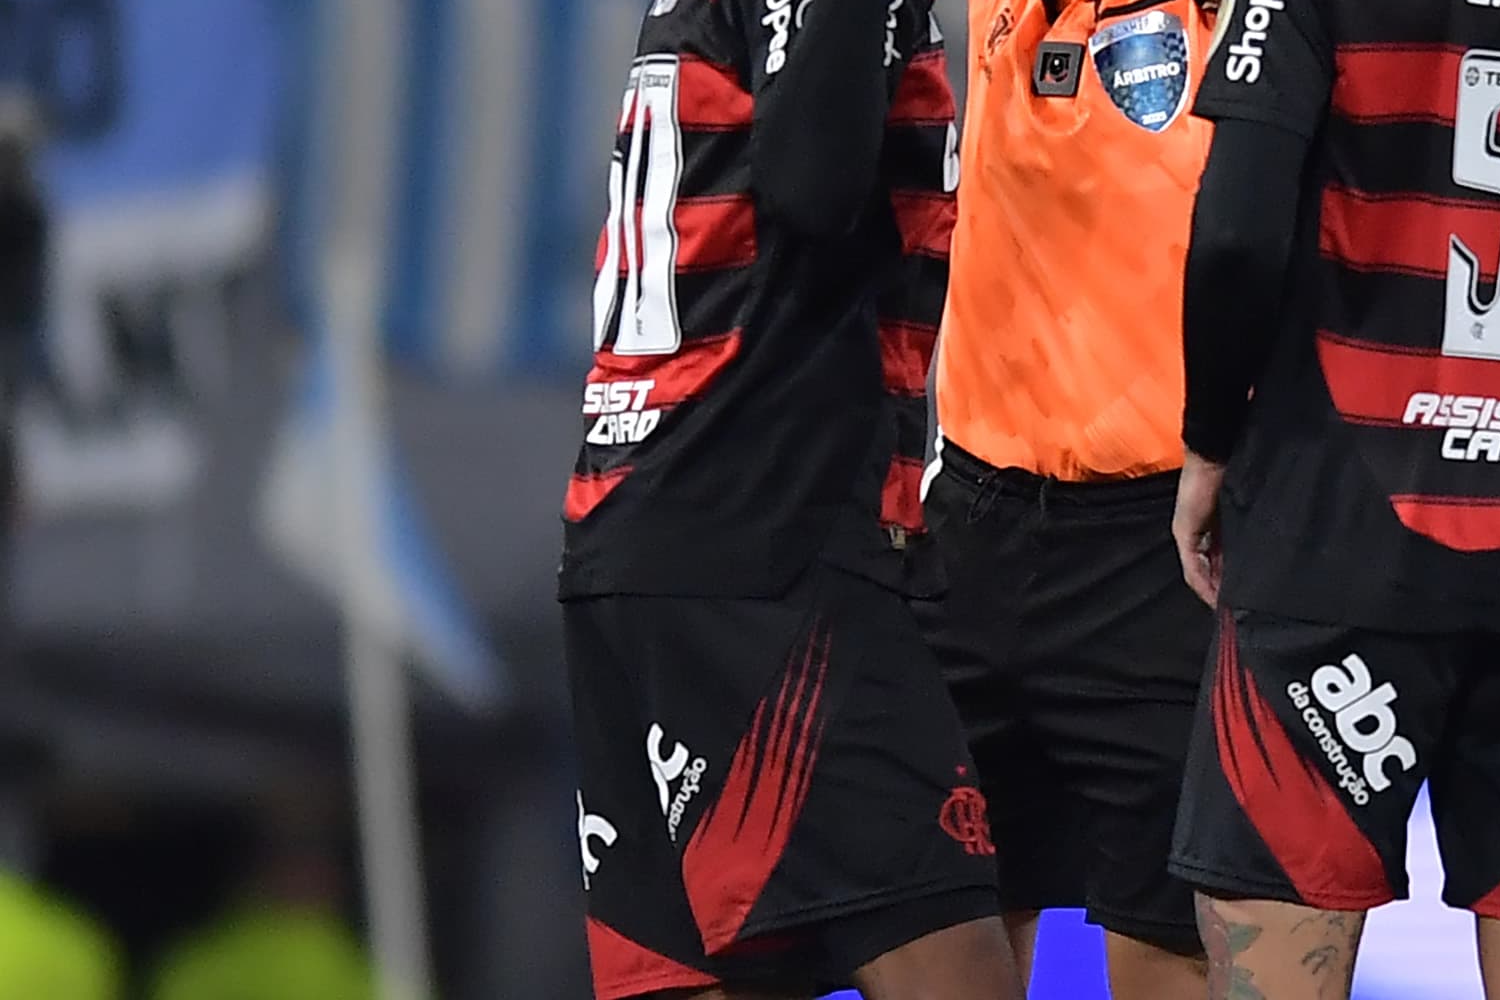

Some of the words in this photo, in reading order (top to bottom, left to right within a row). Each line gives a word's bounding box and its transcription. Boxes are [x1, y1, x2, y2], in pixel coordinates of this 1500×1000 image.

[1113, 62, 1180, 89] ÁRBITRO
[582, 379, 656, 414] SIST
[1286, 681, 1310, 710] da
[1302, 706, 1370, 806] construção
[1310, 652, 1417, 793] abc
